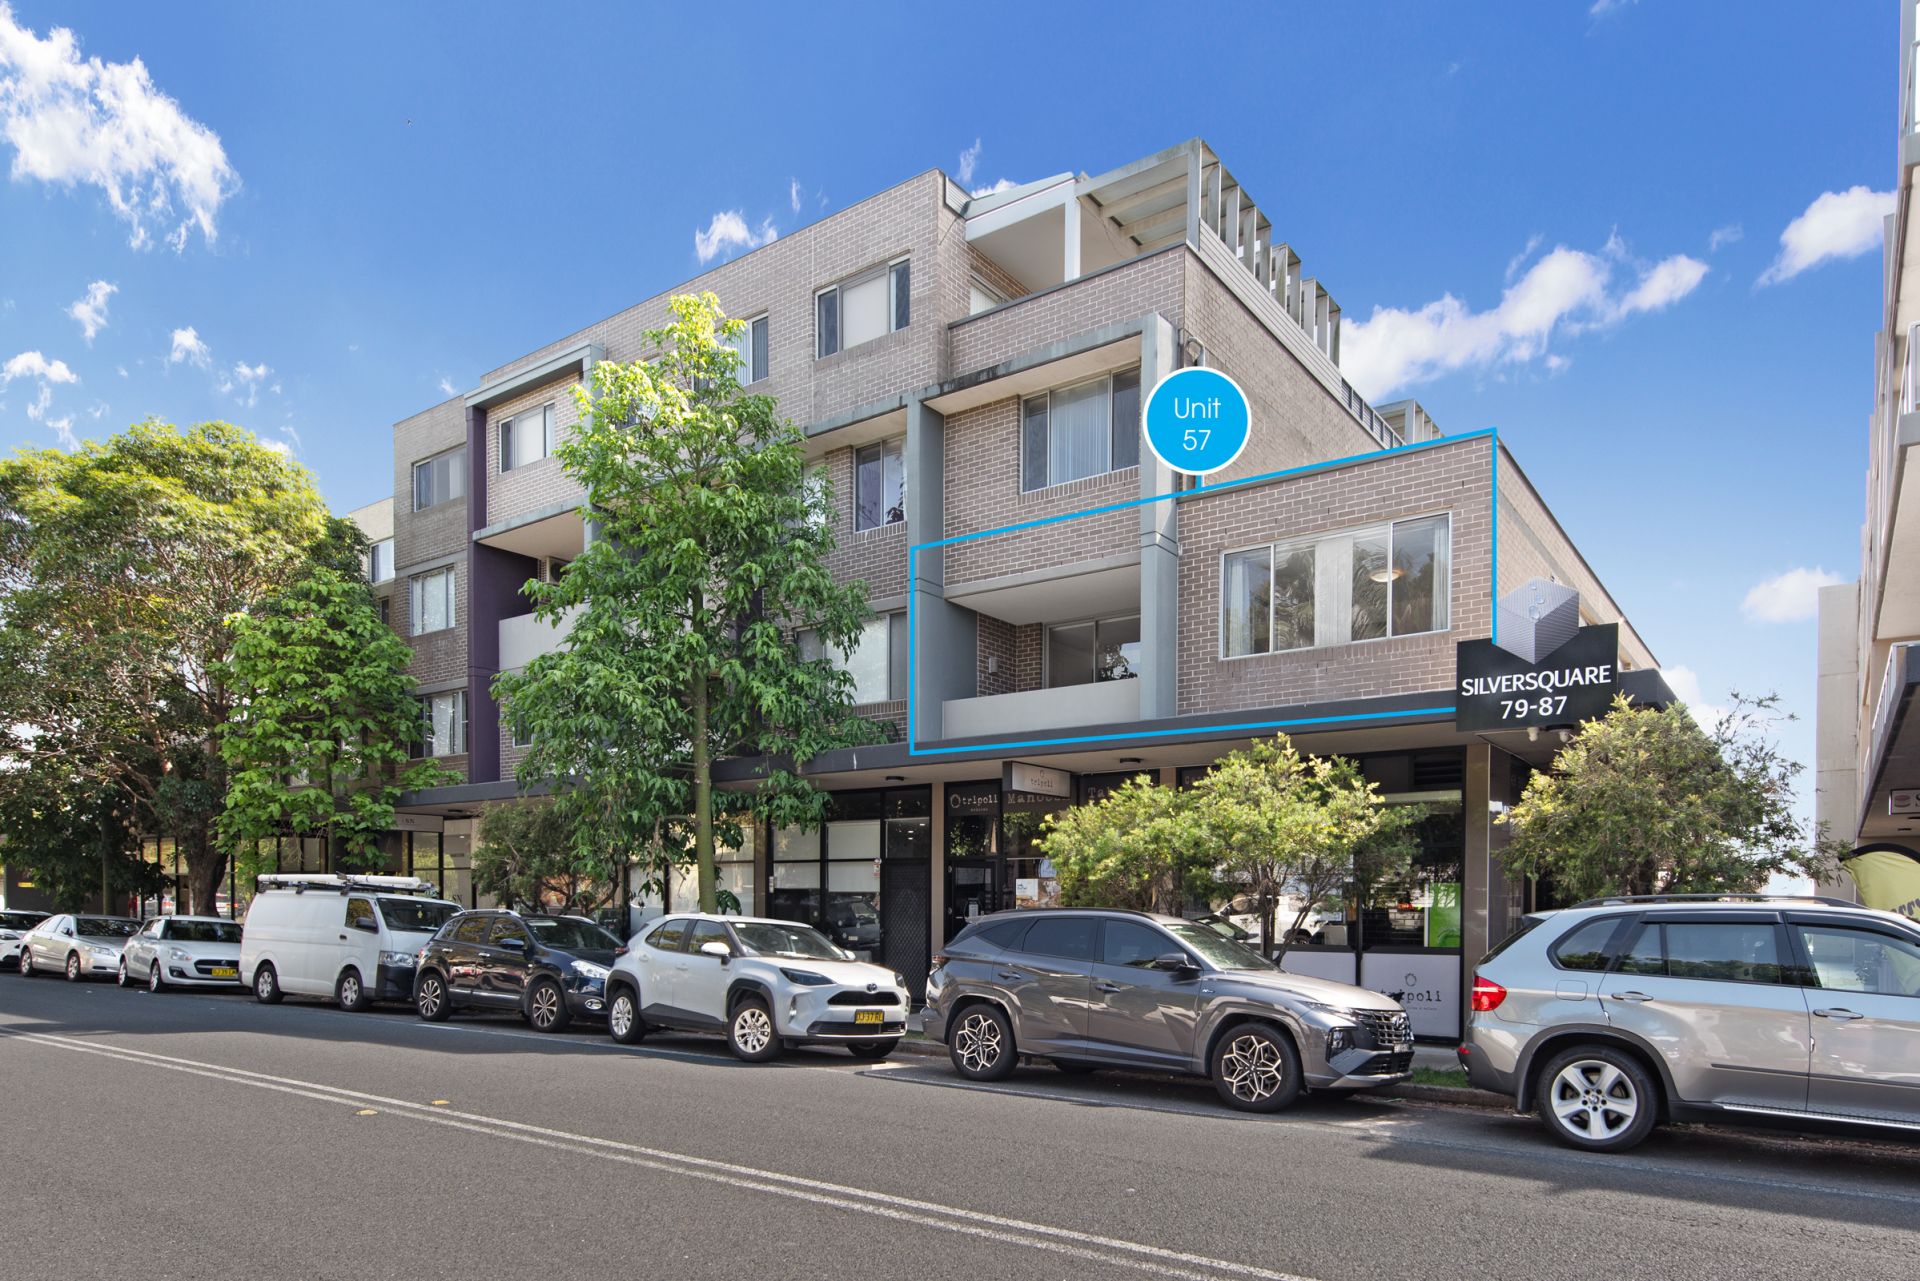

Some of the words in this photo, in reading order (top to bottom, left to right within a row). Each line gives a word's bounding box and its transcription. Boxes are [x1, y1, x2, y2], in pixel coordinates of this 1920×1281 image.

[1461, 664, 1612, 697] SILVERSQUARE
[1500, 695, 1568, 720] 79-87
[962, 793, 999, 807] tripoli
